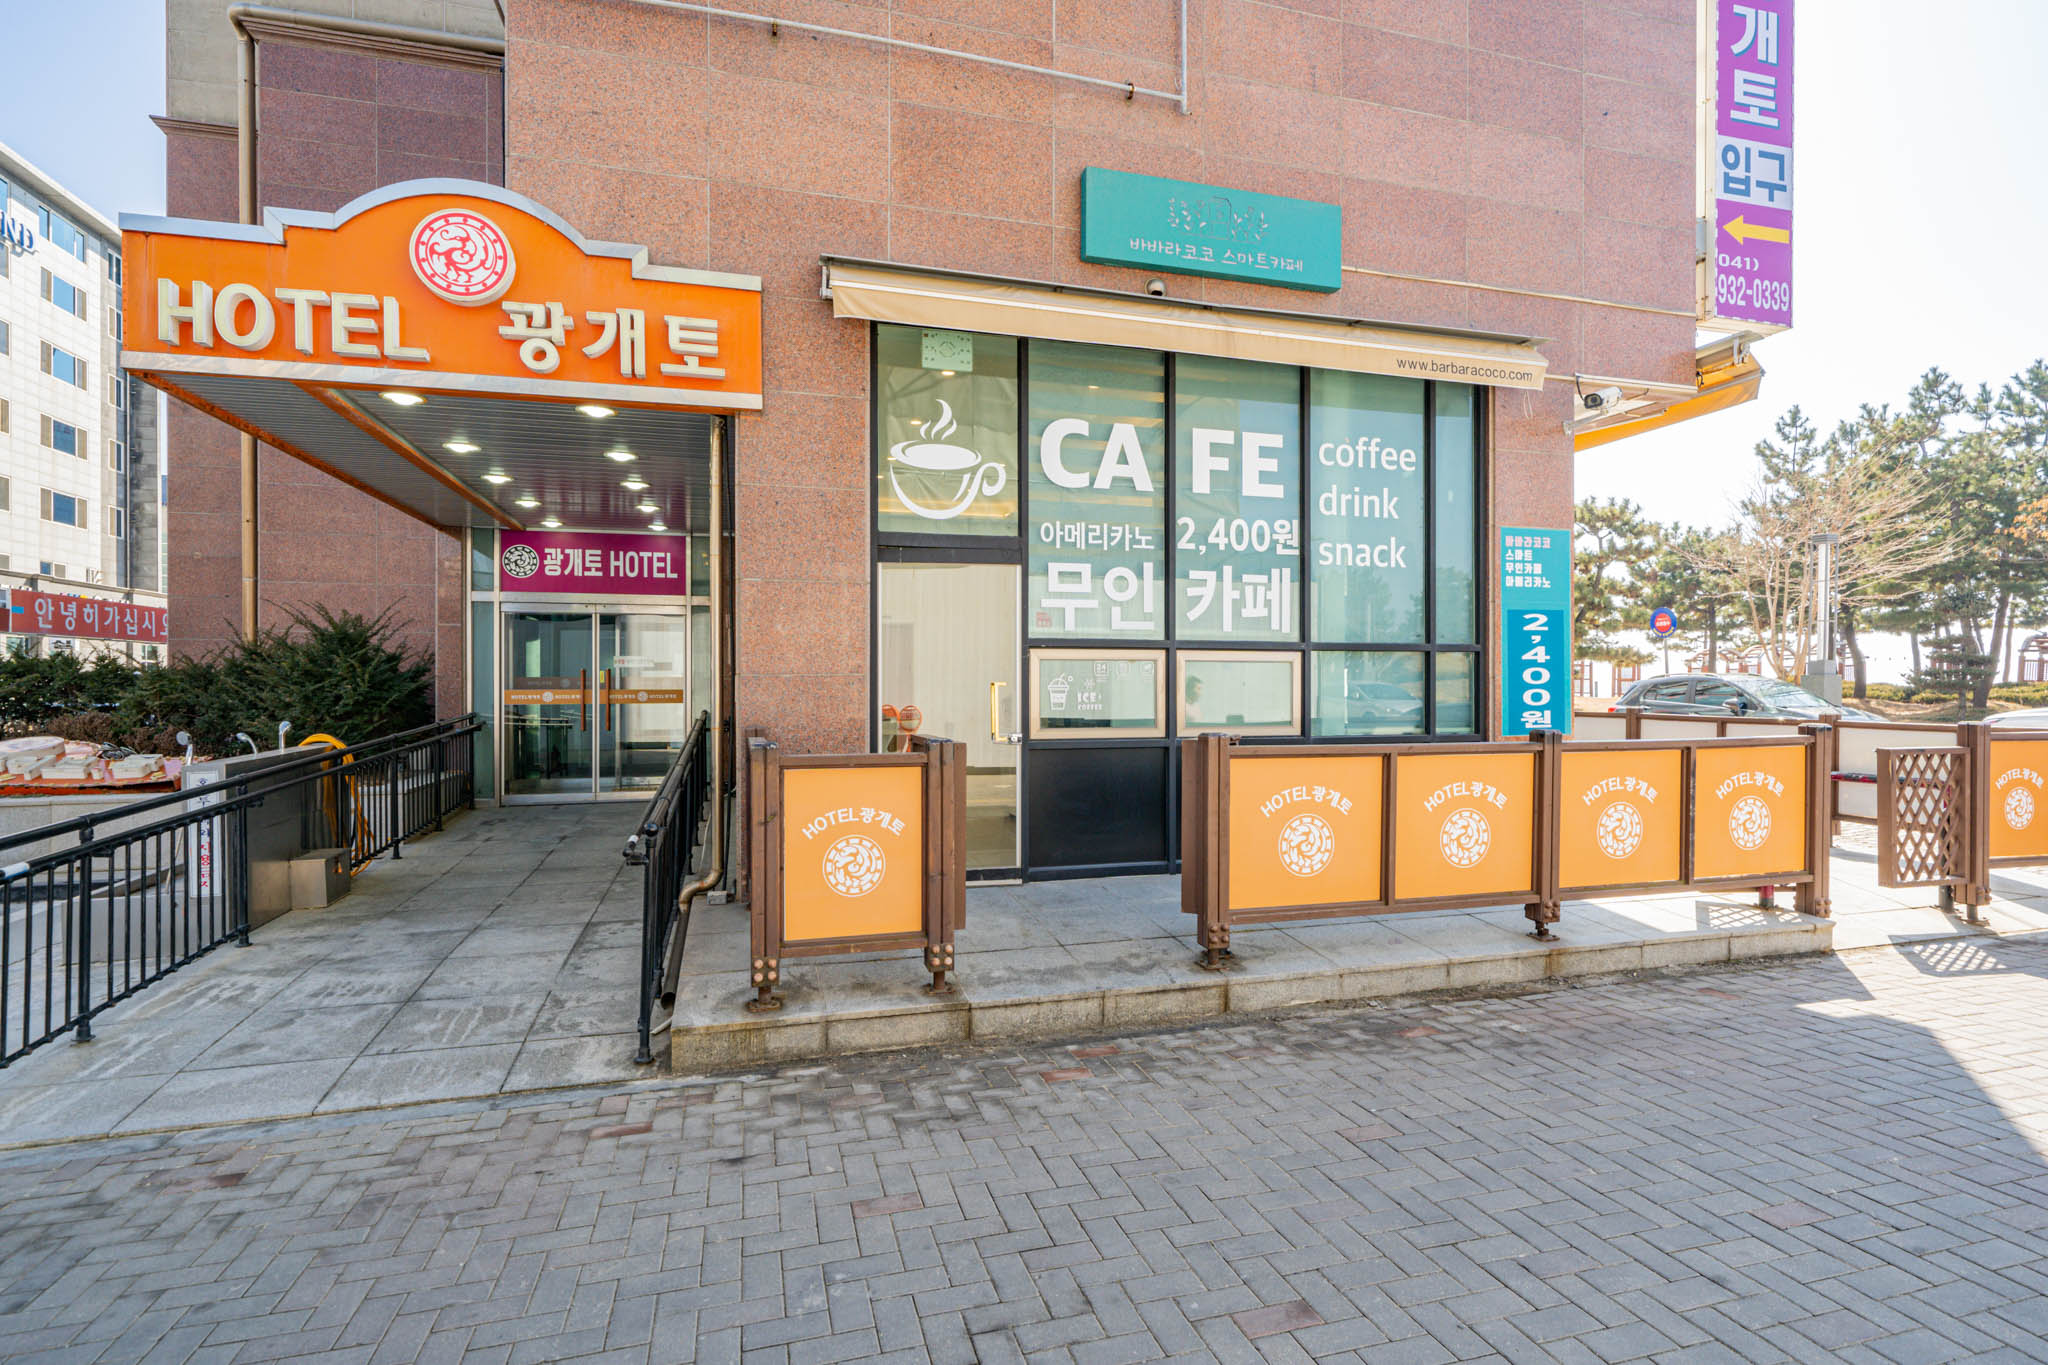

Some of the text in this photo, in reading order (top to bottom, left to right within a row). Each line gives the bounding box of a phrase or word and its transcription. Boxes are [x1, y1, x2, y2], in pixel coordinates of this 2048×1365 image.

[1721, 144, 1787, 203] 입구
[1130, 238, 1304, 272] 바바라코코 스마트카페
[1718, 274, 1789, 312] 932-0339
[158, 278, 726, 380] HOTEL 광개토
[1397, 358, 1533, 382] www.barbaracoco.com
[1318, 437, 1416, 471] coffee
[1318, 484, 1400, 519] drink
[1040, 517, 1299, 556] 아메리카노 2,400원
[1318, 537, 1406, 568] snack
[543, 548, 678, 578] 광개토 HOTEL
